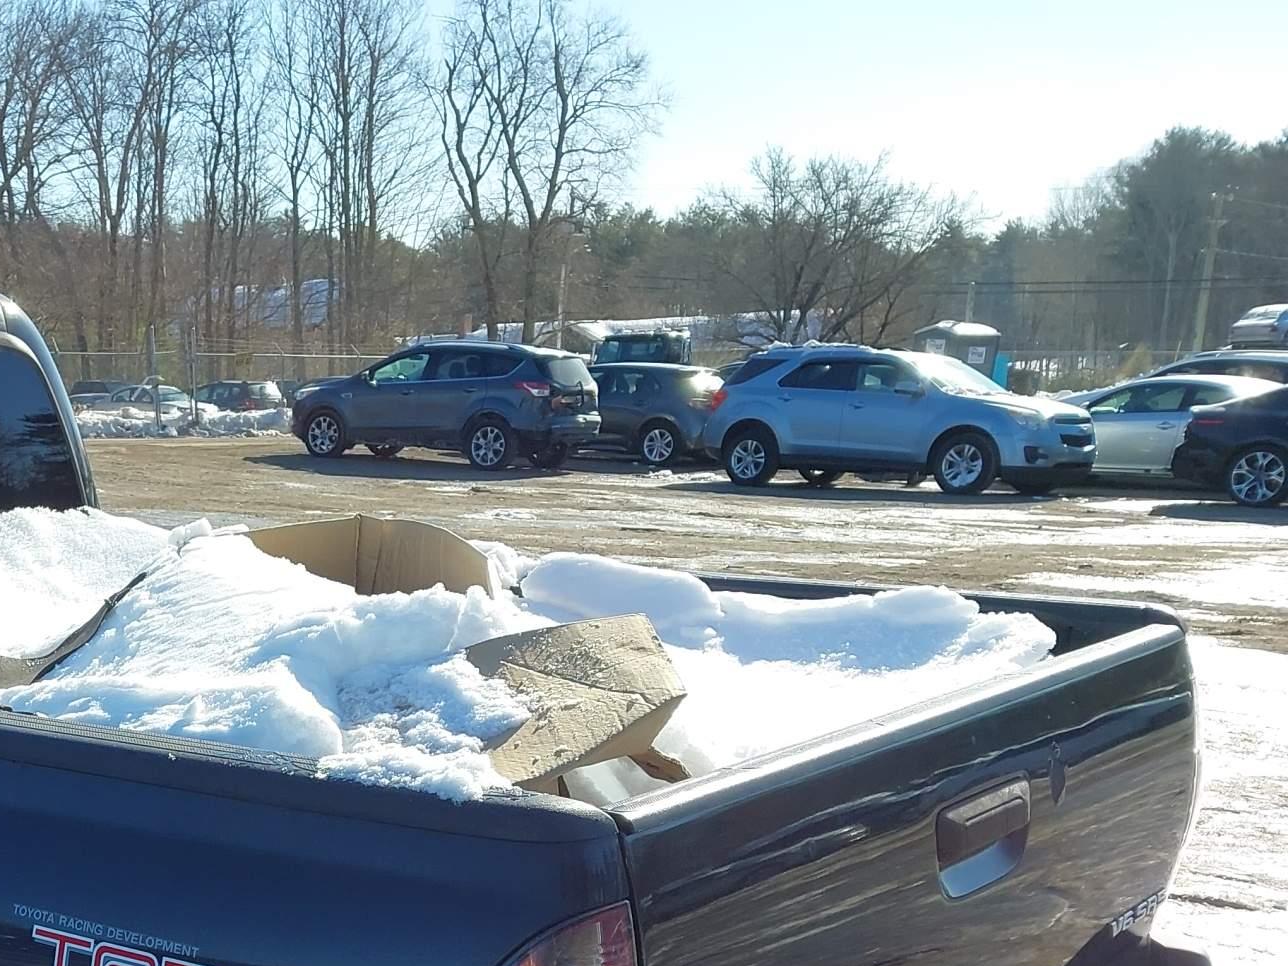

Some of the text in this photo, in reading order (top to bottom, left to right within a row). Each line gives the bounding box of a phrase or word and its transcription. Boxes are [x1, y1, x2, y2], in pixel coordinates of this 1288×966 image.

[13, 903, 200, 958] TOYOTA RACING DEVELOPMENT
